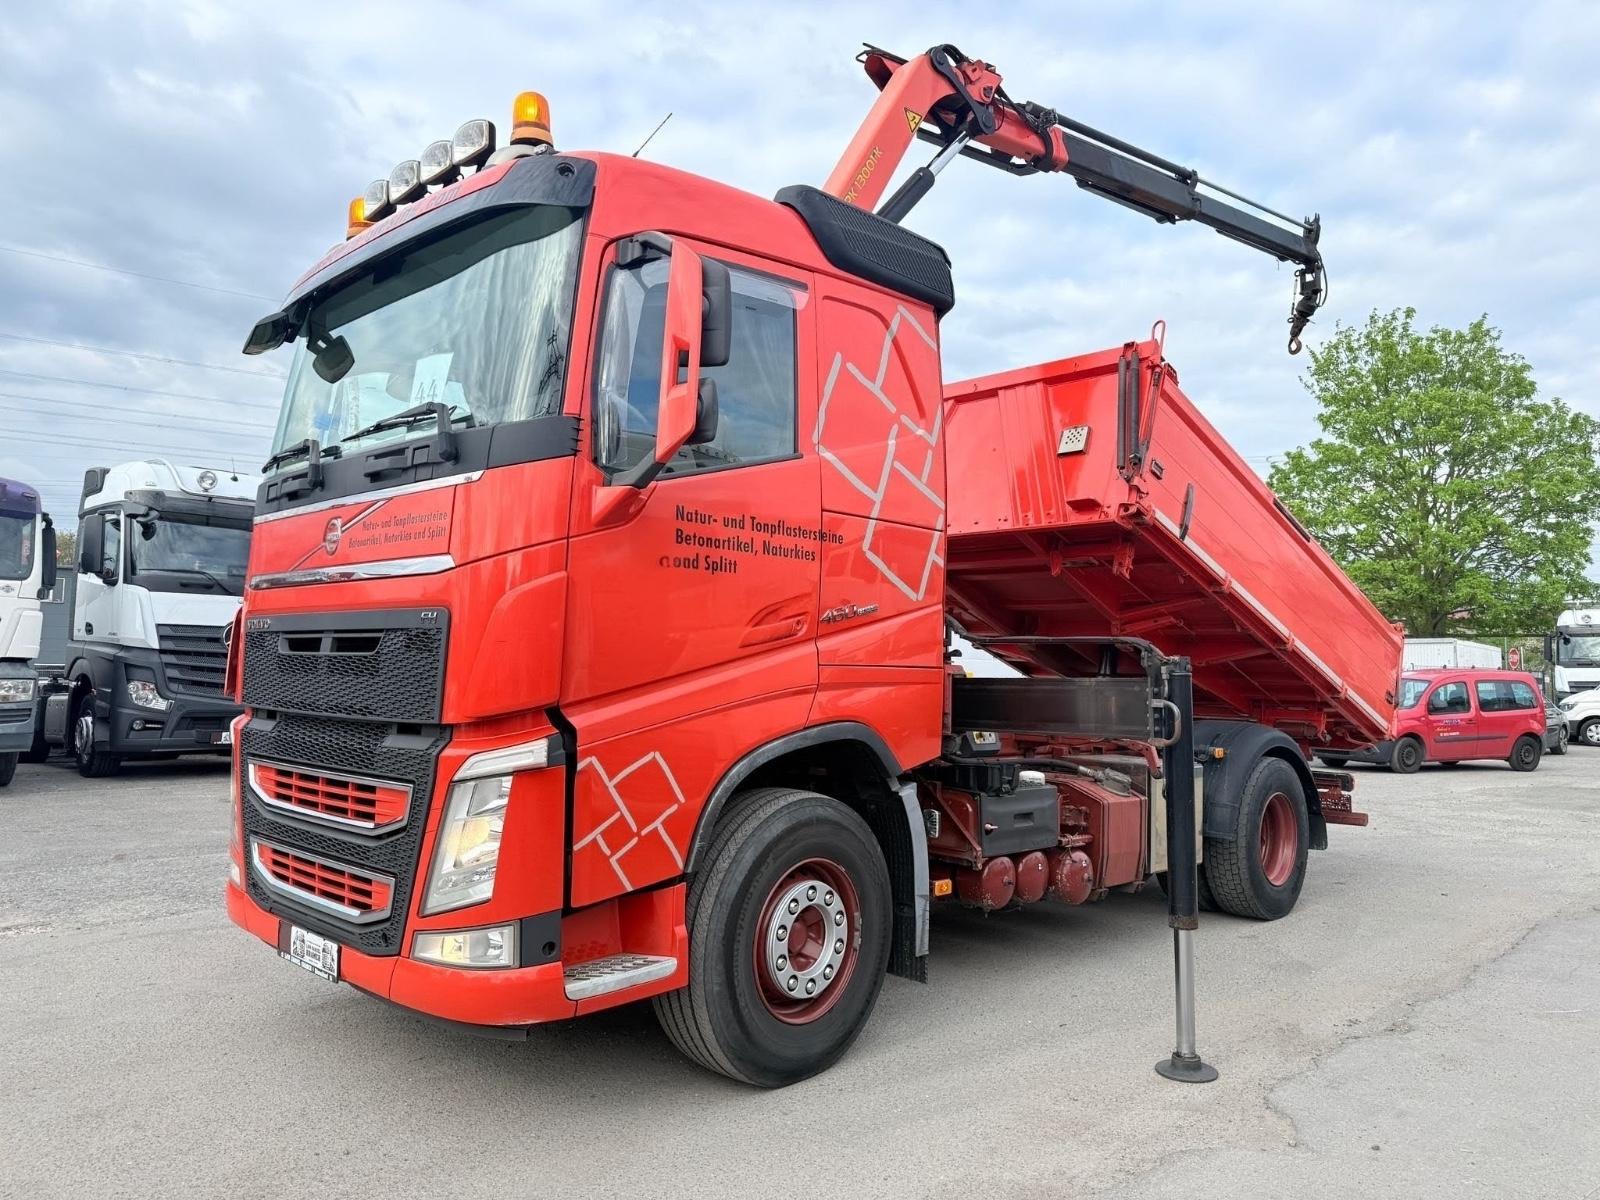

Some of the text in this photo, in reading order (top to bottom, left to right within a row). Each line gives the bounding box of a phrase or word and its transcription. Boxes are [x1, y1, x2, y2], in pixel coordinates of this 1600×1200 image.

[676, 505, 844, 545] Natur- und Tonpflastersteine
[676, 528, 816, 561] Betonartikel, Naturkies
[704, 554, 738, 575] Splitt
